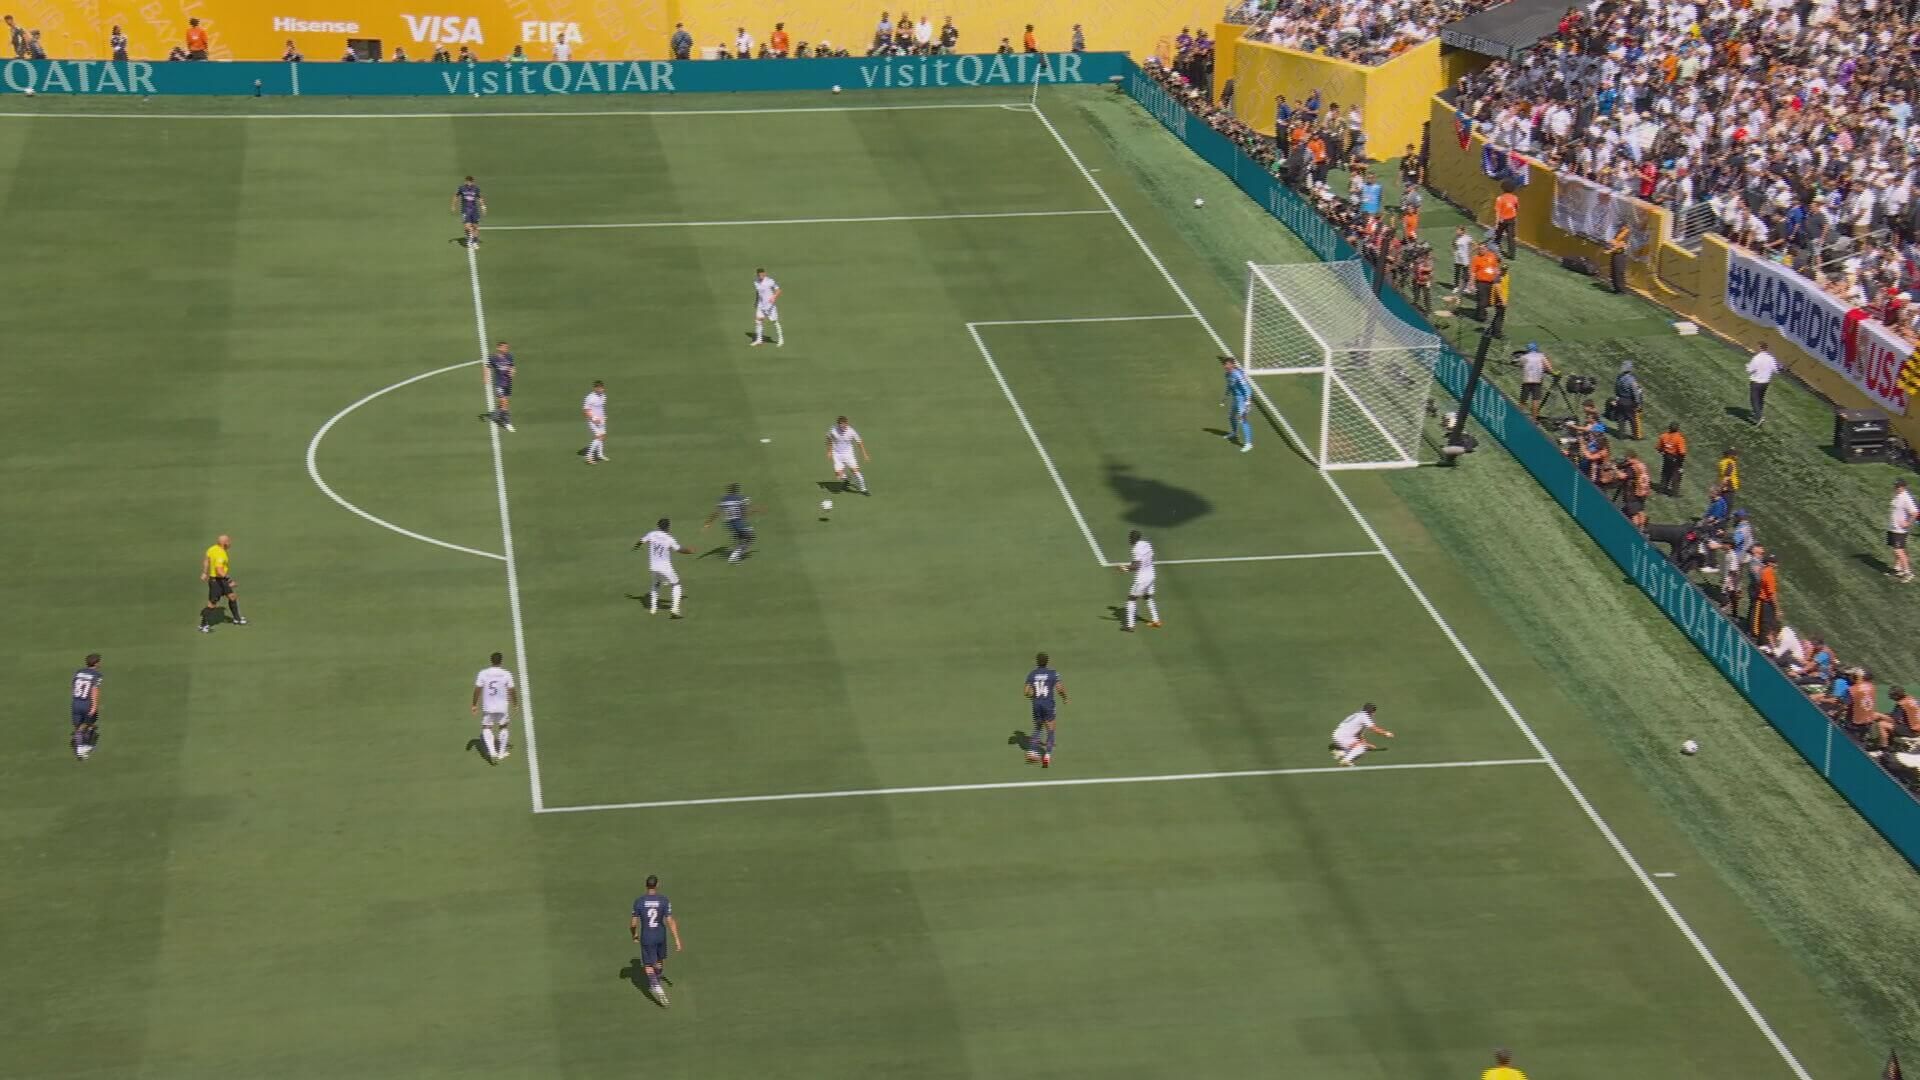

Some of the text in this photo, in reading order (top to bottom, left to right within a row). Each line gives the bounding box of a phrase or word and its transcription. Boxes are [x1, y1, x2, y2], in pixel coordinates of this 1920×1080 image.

[273, 16, 360, 33] Hisense
[401, 15, 484, 44] VISA
[521, 21, 583, 43] FIFA
[4, 60, 157, 93] QATAR
[1865, 342, 1907, 407] USA
[489, 681, 498, 696] 5
[1034, 681, 1049, 697] 14
[647, 908, 659, 927] 2
